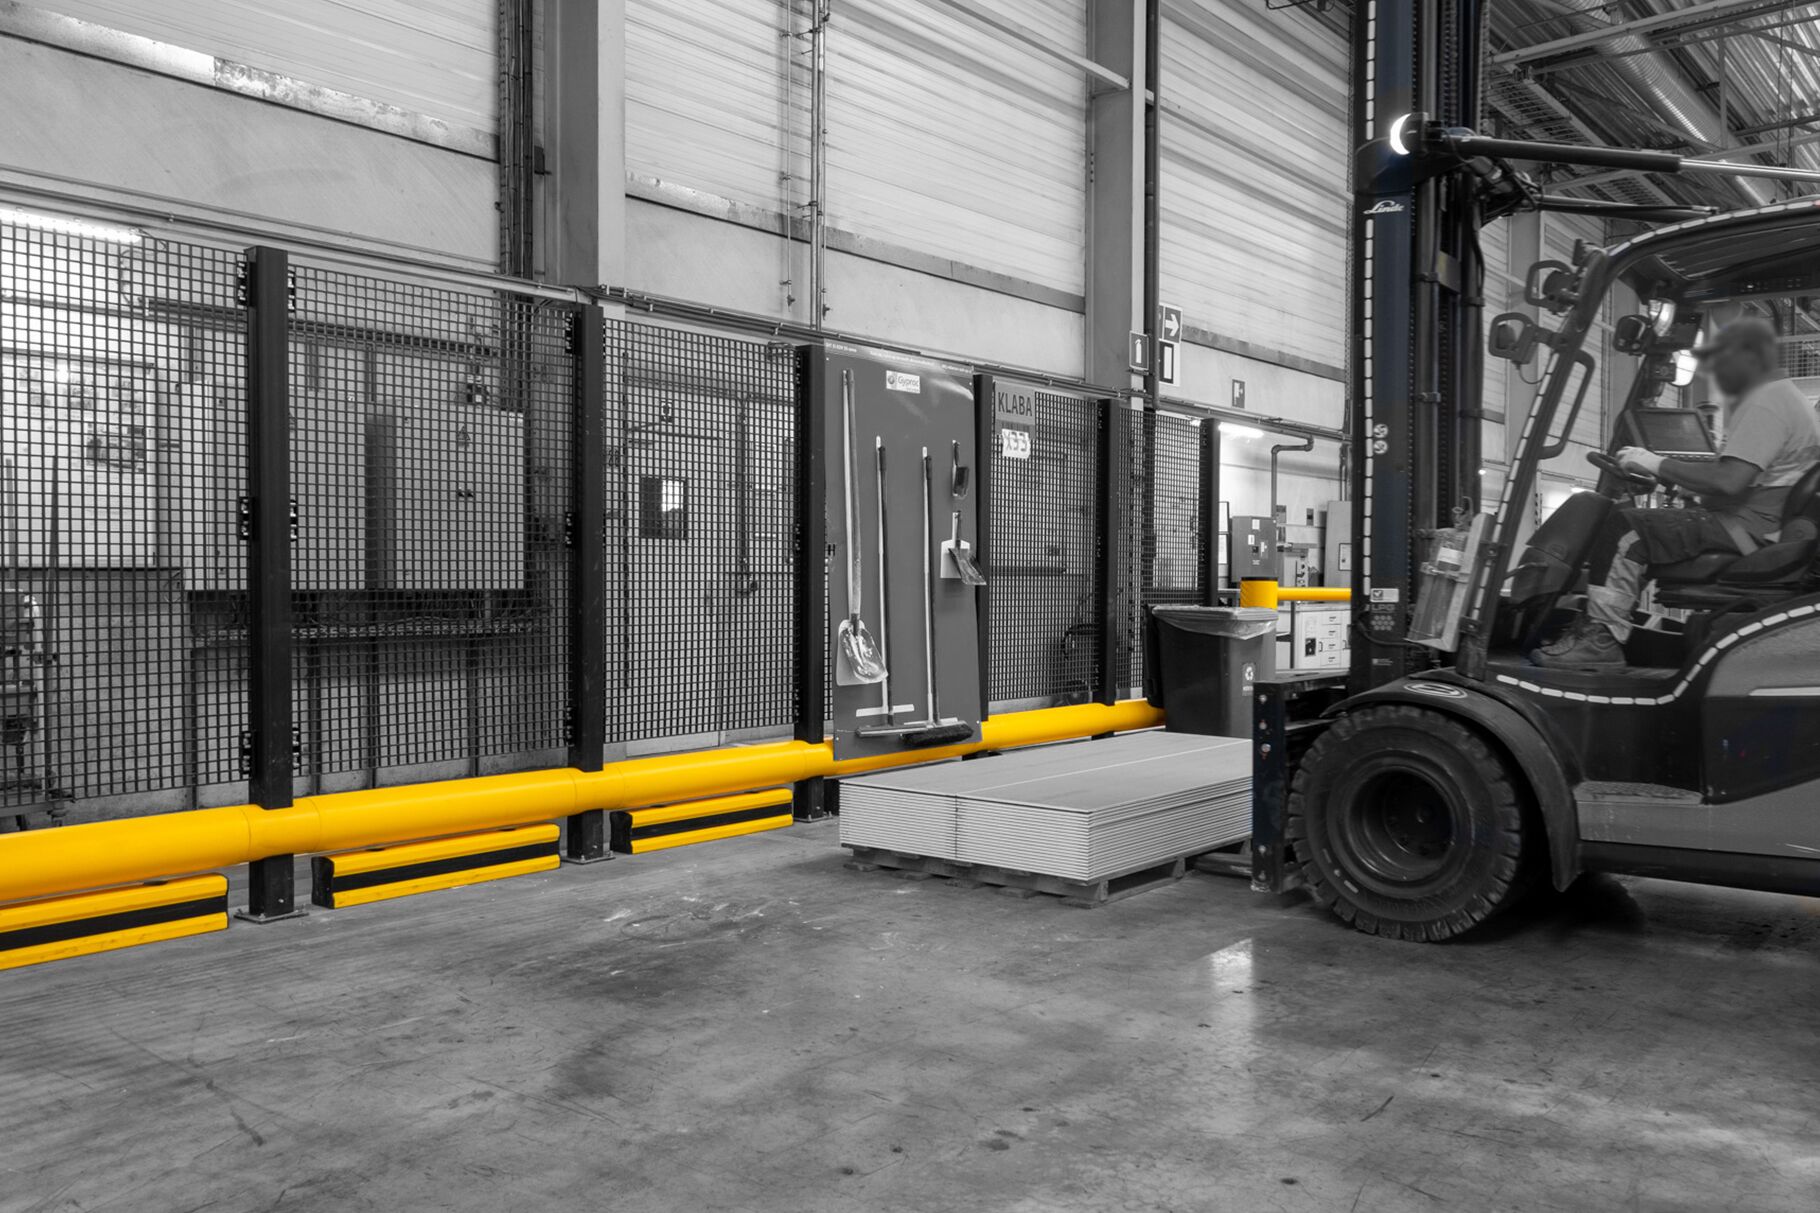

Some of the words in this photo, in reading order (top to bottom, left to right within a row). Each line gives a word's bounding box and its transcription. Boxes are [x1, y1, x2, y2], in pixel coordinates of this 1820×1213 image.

[1363, 200, 1404, 214] Linde
[898, 376, 919, 387] Gyproc
[998, 391, 1032, 416] KLABA
